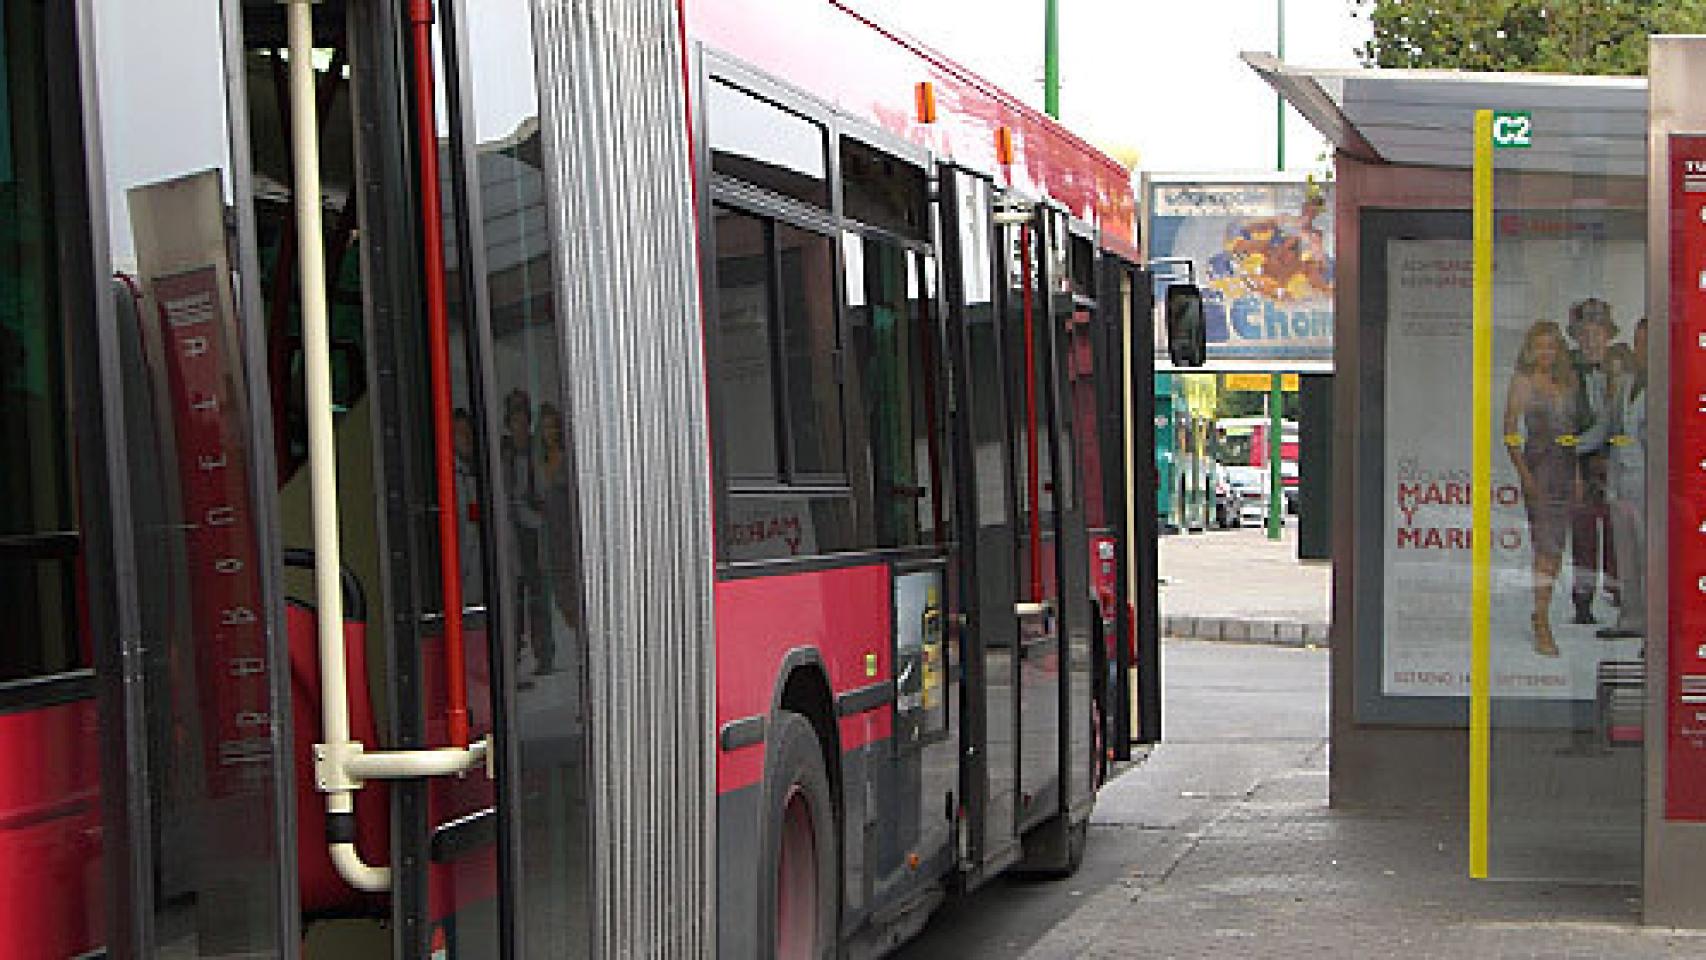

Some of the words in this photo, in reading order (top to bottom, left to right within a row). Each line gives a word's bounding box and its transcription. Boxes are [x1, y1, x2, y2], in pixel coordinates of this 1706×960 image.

[1494, 116, 1529, 145] C2
[1397, 483, 1518, 504] MARIO
[1397, 528, 1521, 549] MARIO
